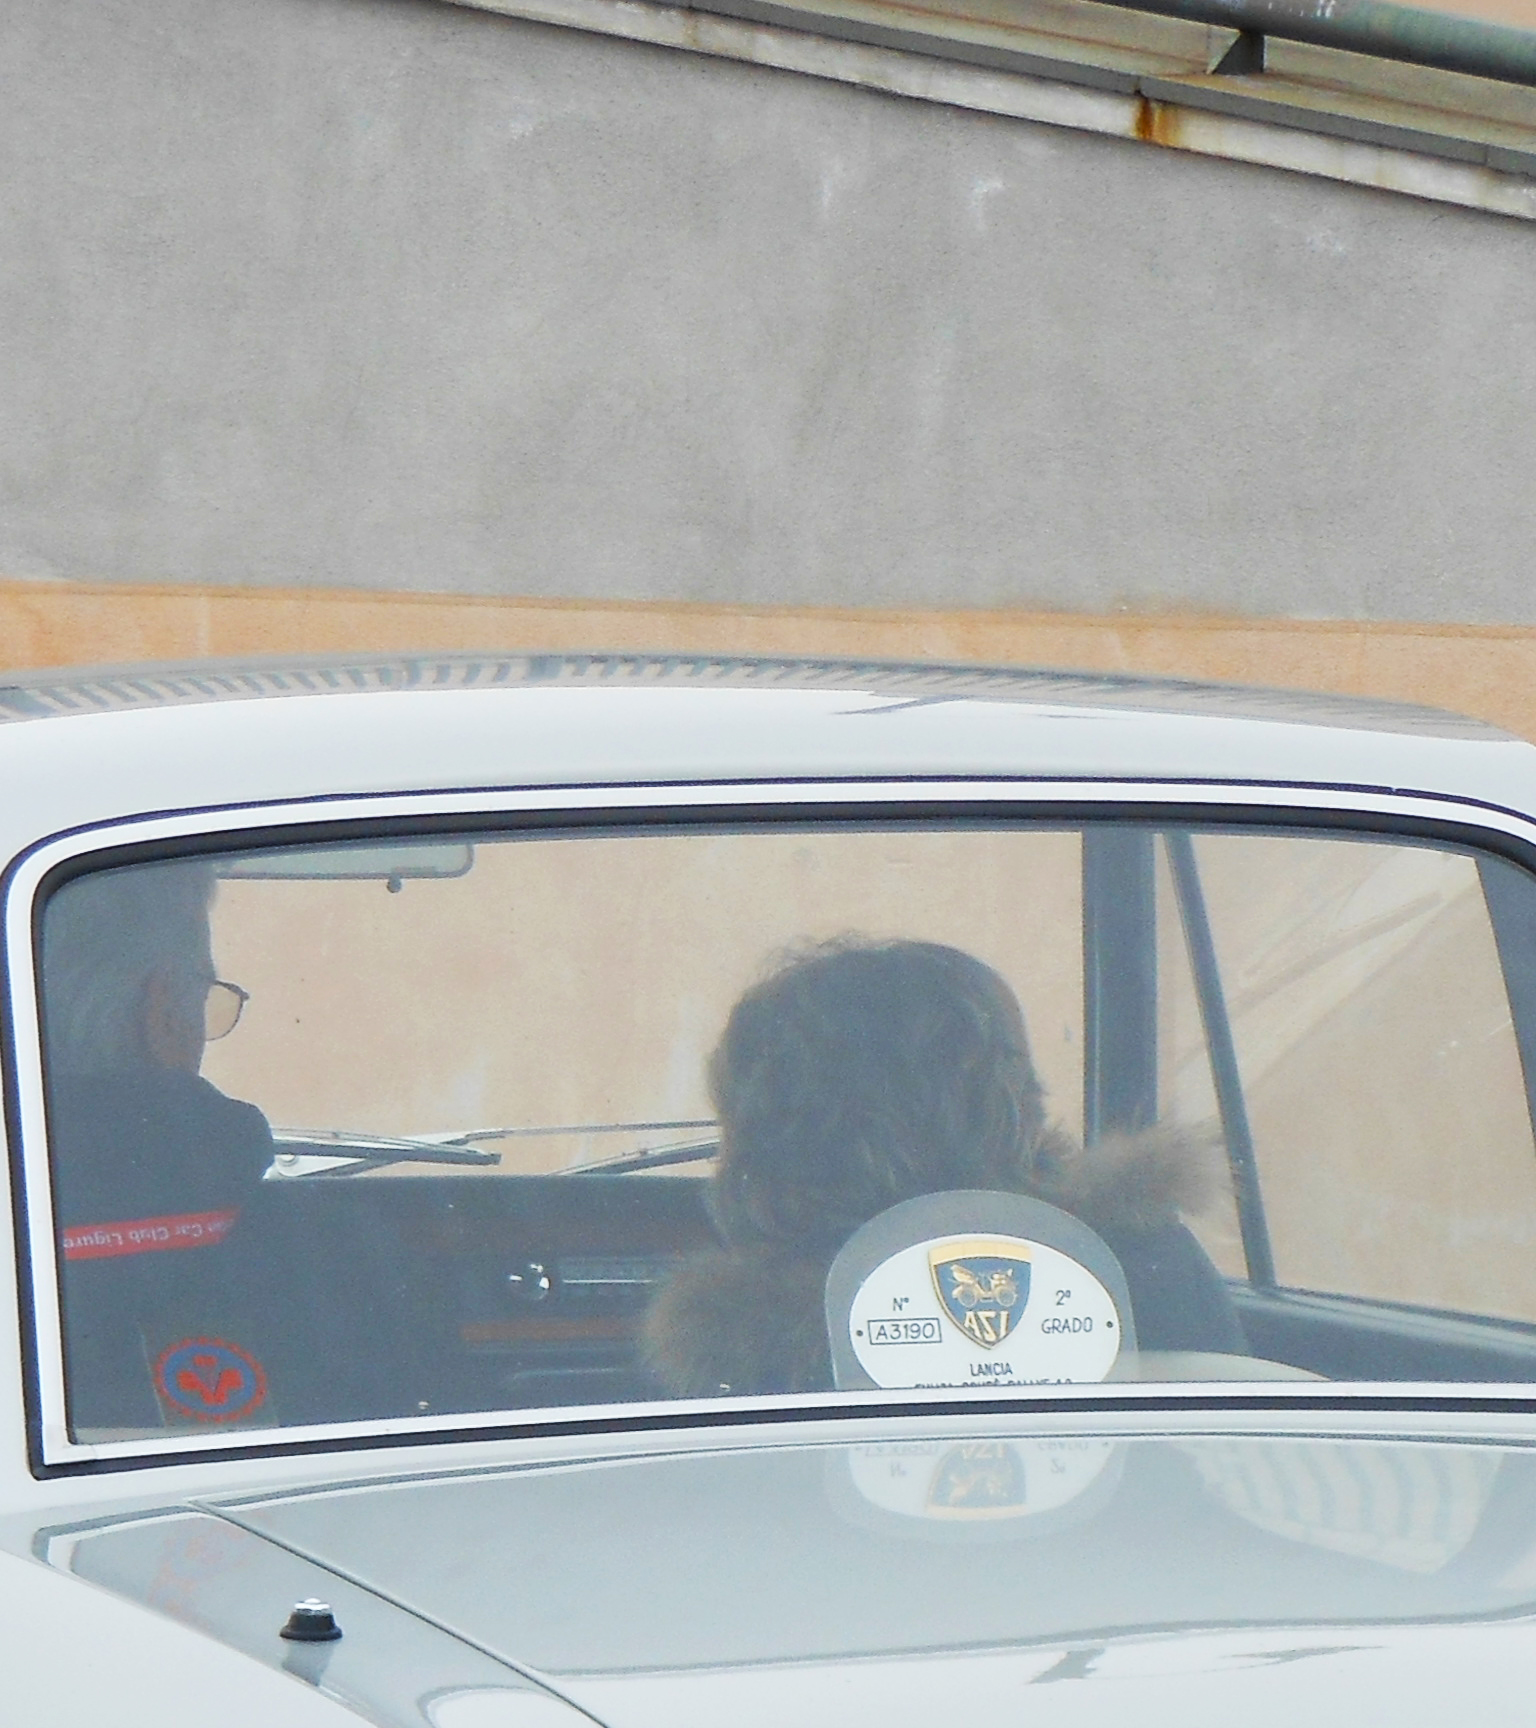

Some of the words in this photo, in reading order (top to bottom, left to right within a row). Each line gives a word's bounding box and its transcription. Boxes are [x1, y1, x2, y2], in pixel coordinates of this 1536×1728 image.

[129, 1226, 170, 1244] Club
[175, 1222, 202, 1238] Car
[63, 1230, 123, 1250] Ligure
[875, 1321, 936, 1341] A3190
[1041, 1316, 1094, 1335] GRADO
[969, 1361, 1014, 1377] LANCIA
